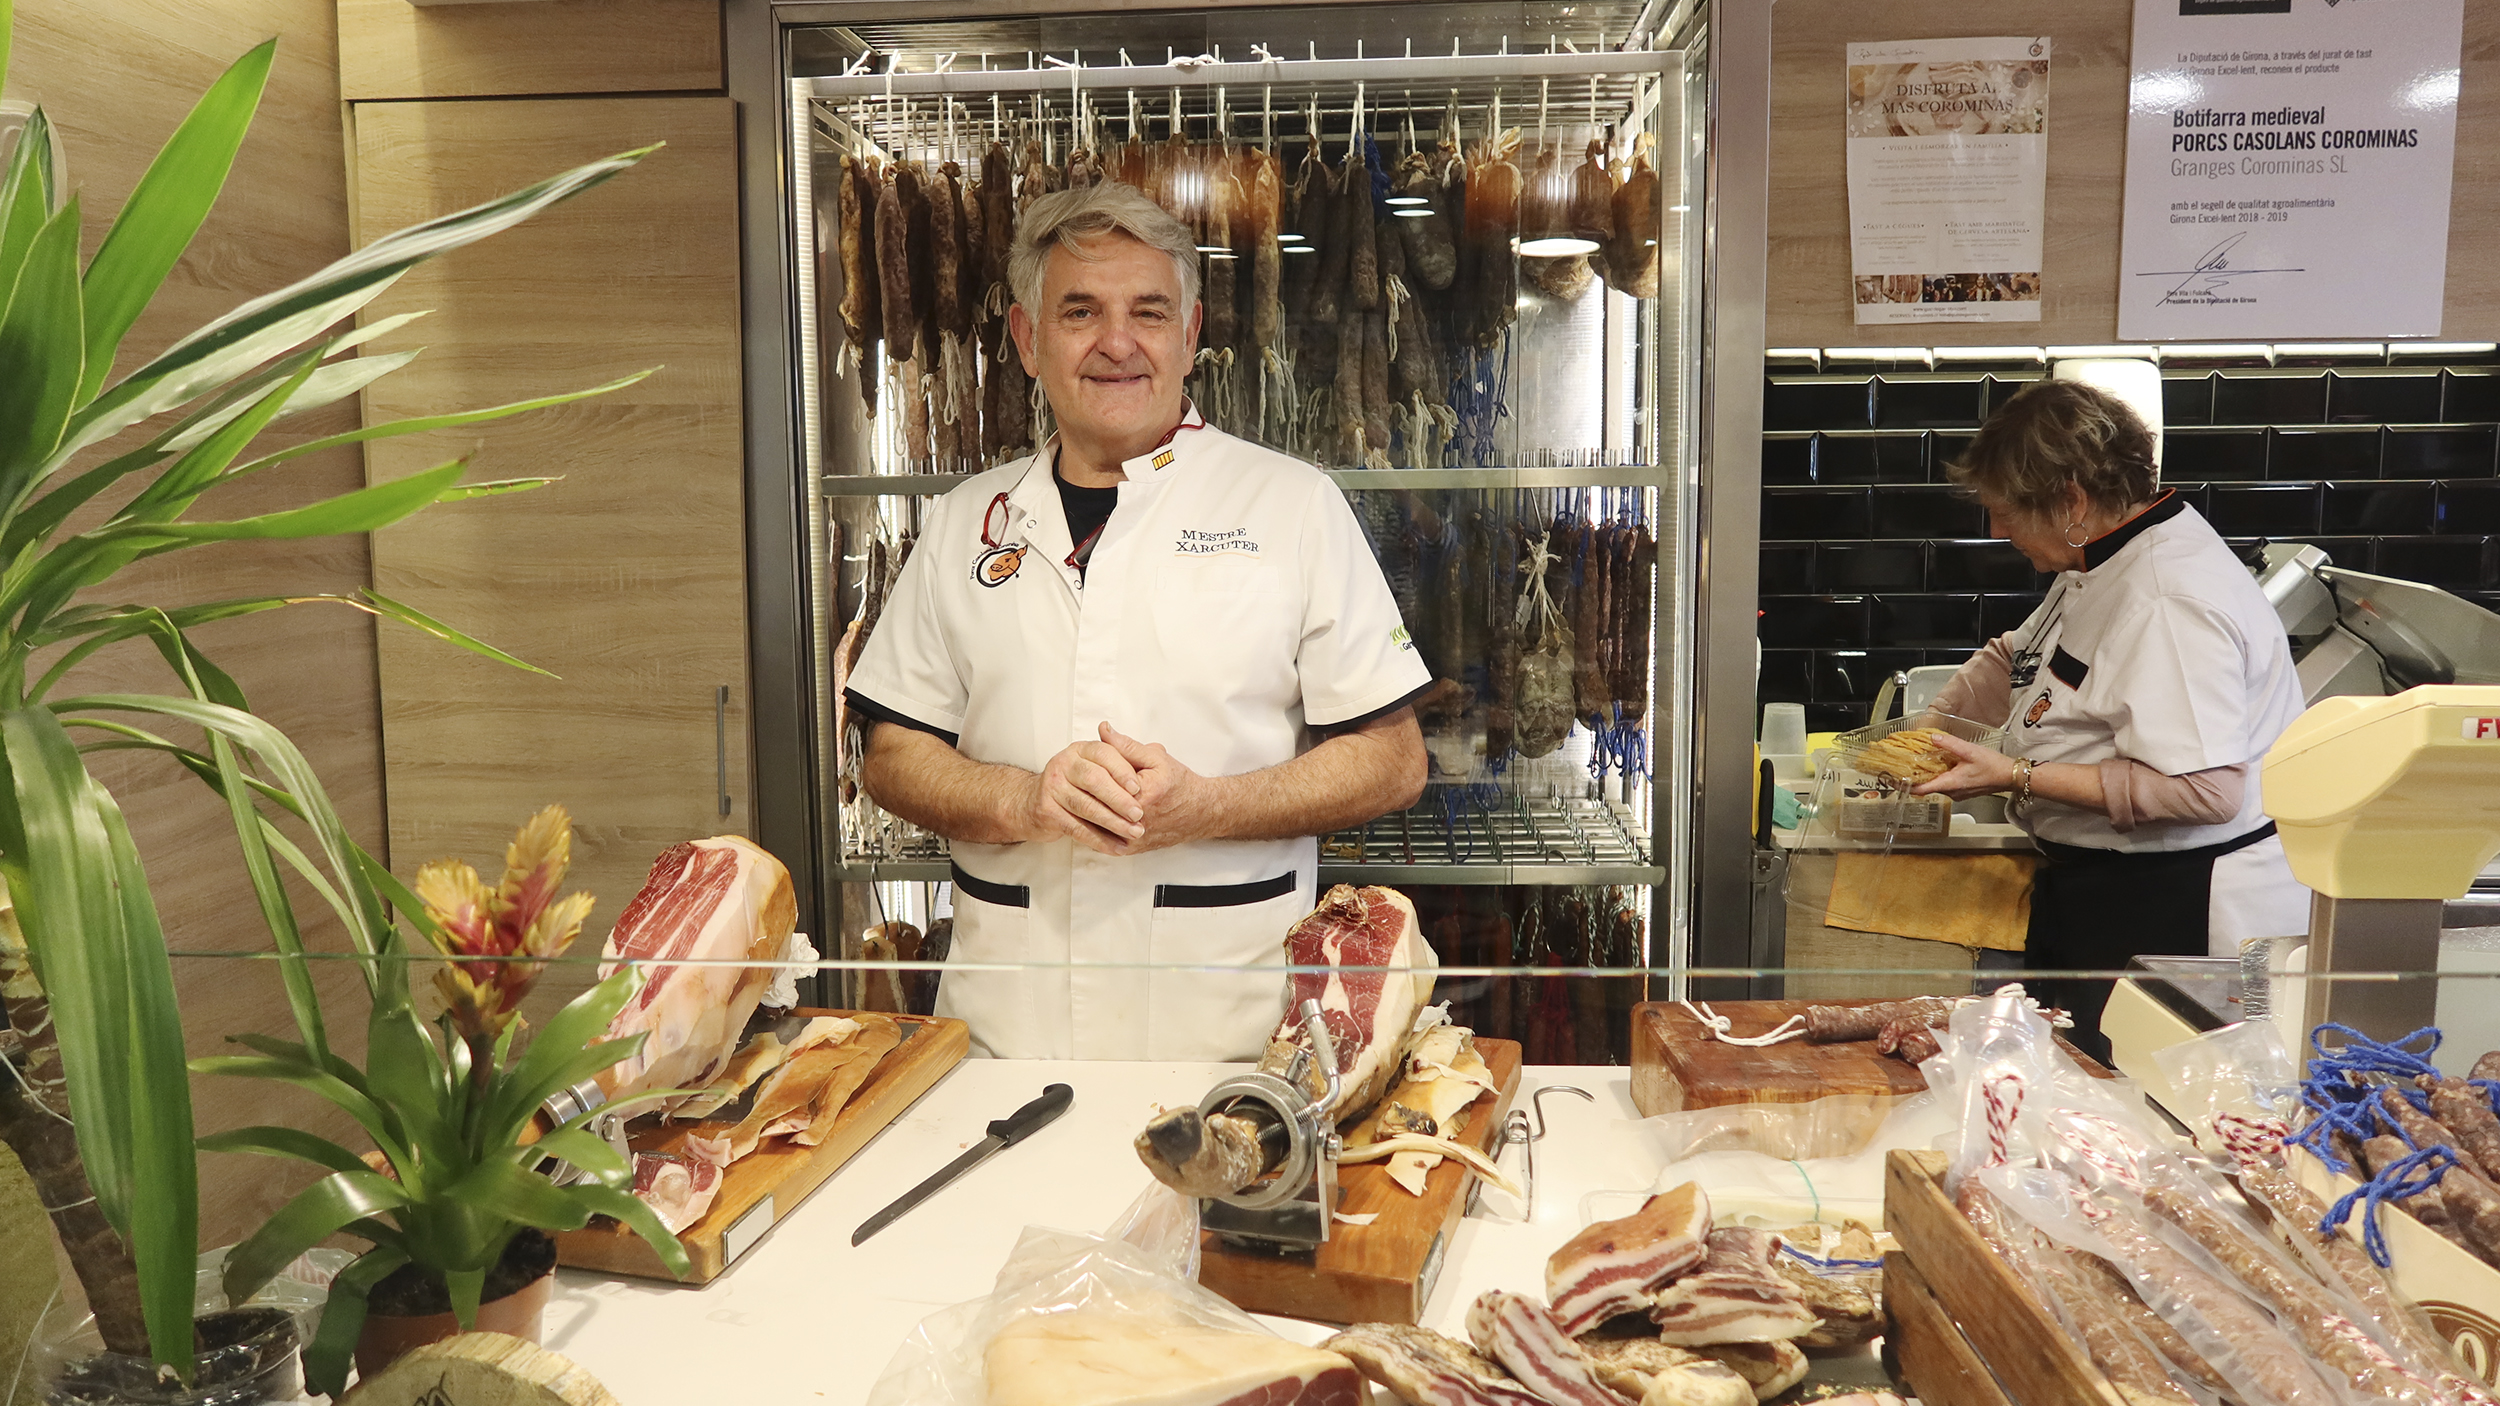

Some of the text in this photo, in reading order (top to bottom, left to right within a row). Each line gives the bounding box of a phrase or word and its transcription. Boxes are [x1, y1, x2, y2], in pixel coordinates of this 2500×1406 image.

[2178, 49, 2373, 64] La Diputació de Girona, a través del jurat de tast
[2260, 65, 2293, 74] reconeix
[2295, 64, 2302, 73] el
[2304, 64, 2340, 75] producte
[1896, 82, 1978, 97] DISFRUTA
[1881, 99, 2014, 115] MAS COROMINAS
[2173, 106, 2325, 128] Botifarra medieval
[2172, 129, 2418, 152] PORCS CASOLANS COROMINAS
[2171, 155, 2348, 179] Granges Corominas SL
[2171, 199, 2335, 212] amb el segell de qualitat agroalimentària
[2170, 214, 2196, 224] Girona
[2238, 213, 2259, 222] 2018
[2267, 212, 2288, 222] 2019
[1181, 527, 1247, 541] MESTRE
[1175, 540, 1259, 553] XARCUTER
